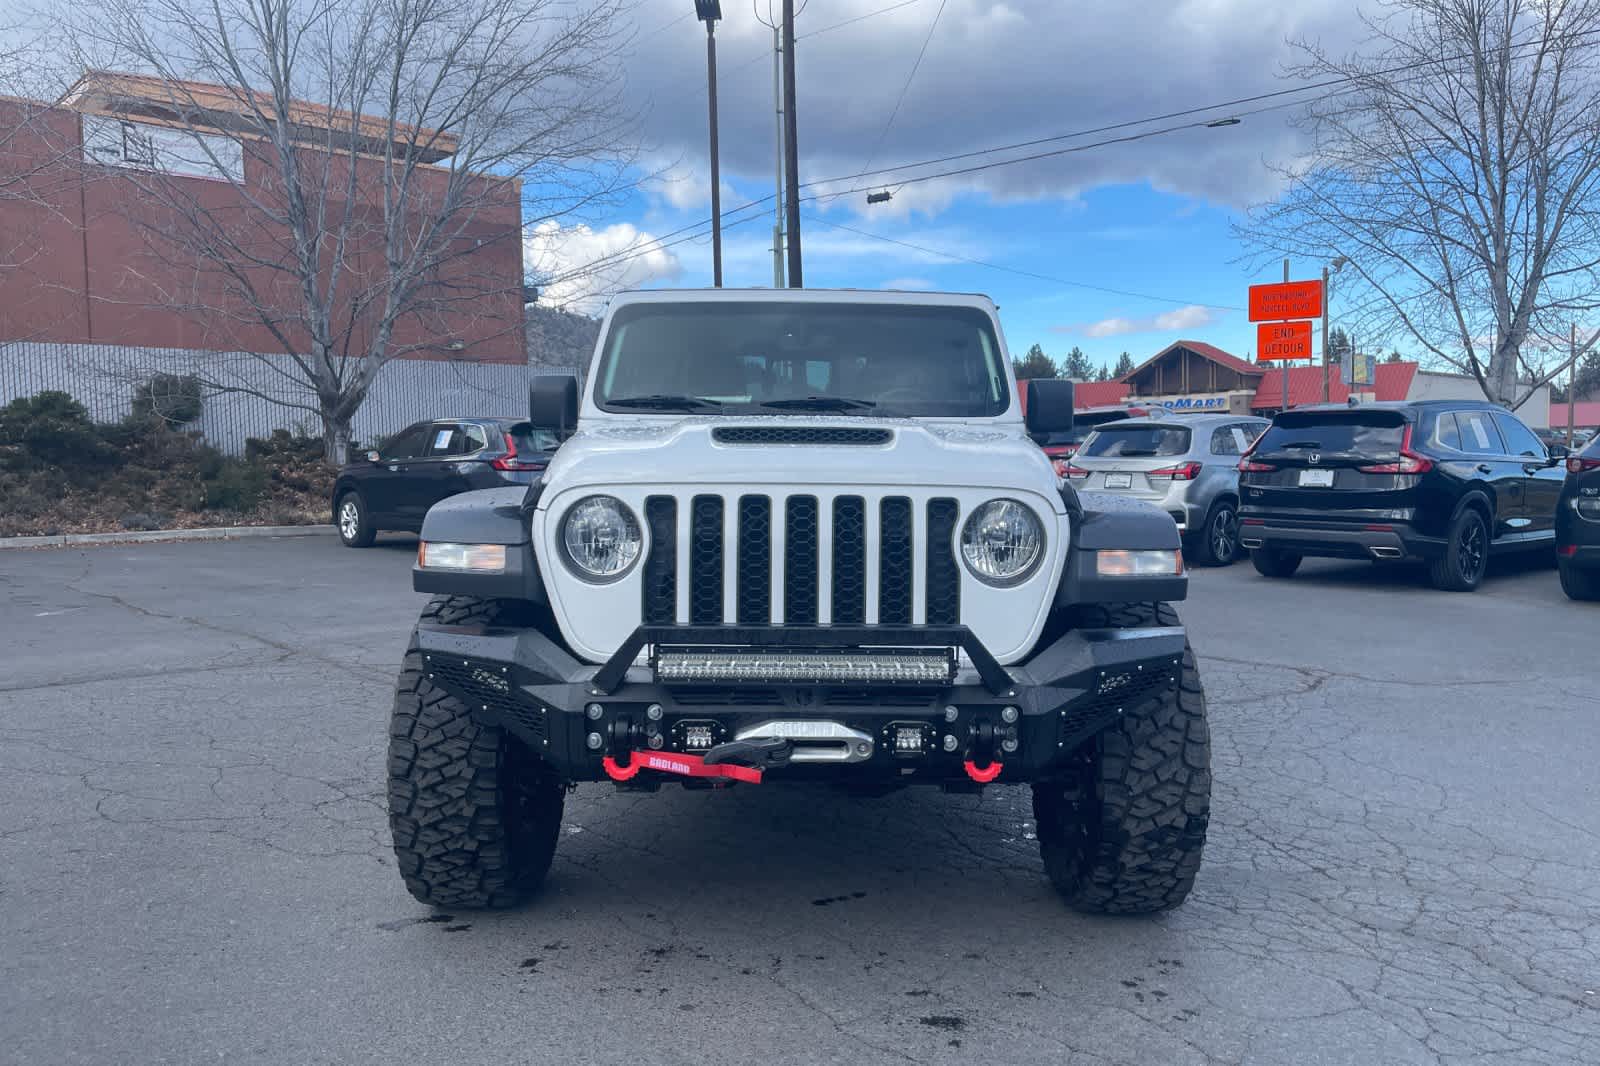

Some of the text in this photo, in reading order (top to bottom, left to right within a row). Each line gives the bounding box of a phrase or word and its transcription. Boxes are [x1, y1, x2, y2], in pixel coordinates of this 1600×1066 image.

[1273, 327, 1296, 339] END
[1264, 342, 1304, 355] DETOUR
[649, 756, 690, 775] BADLAND
